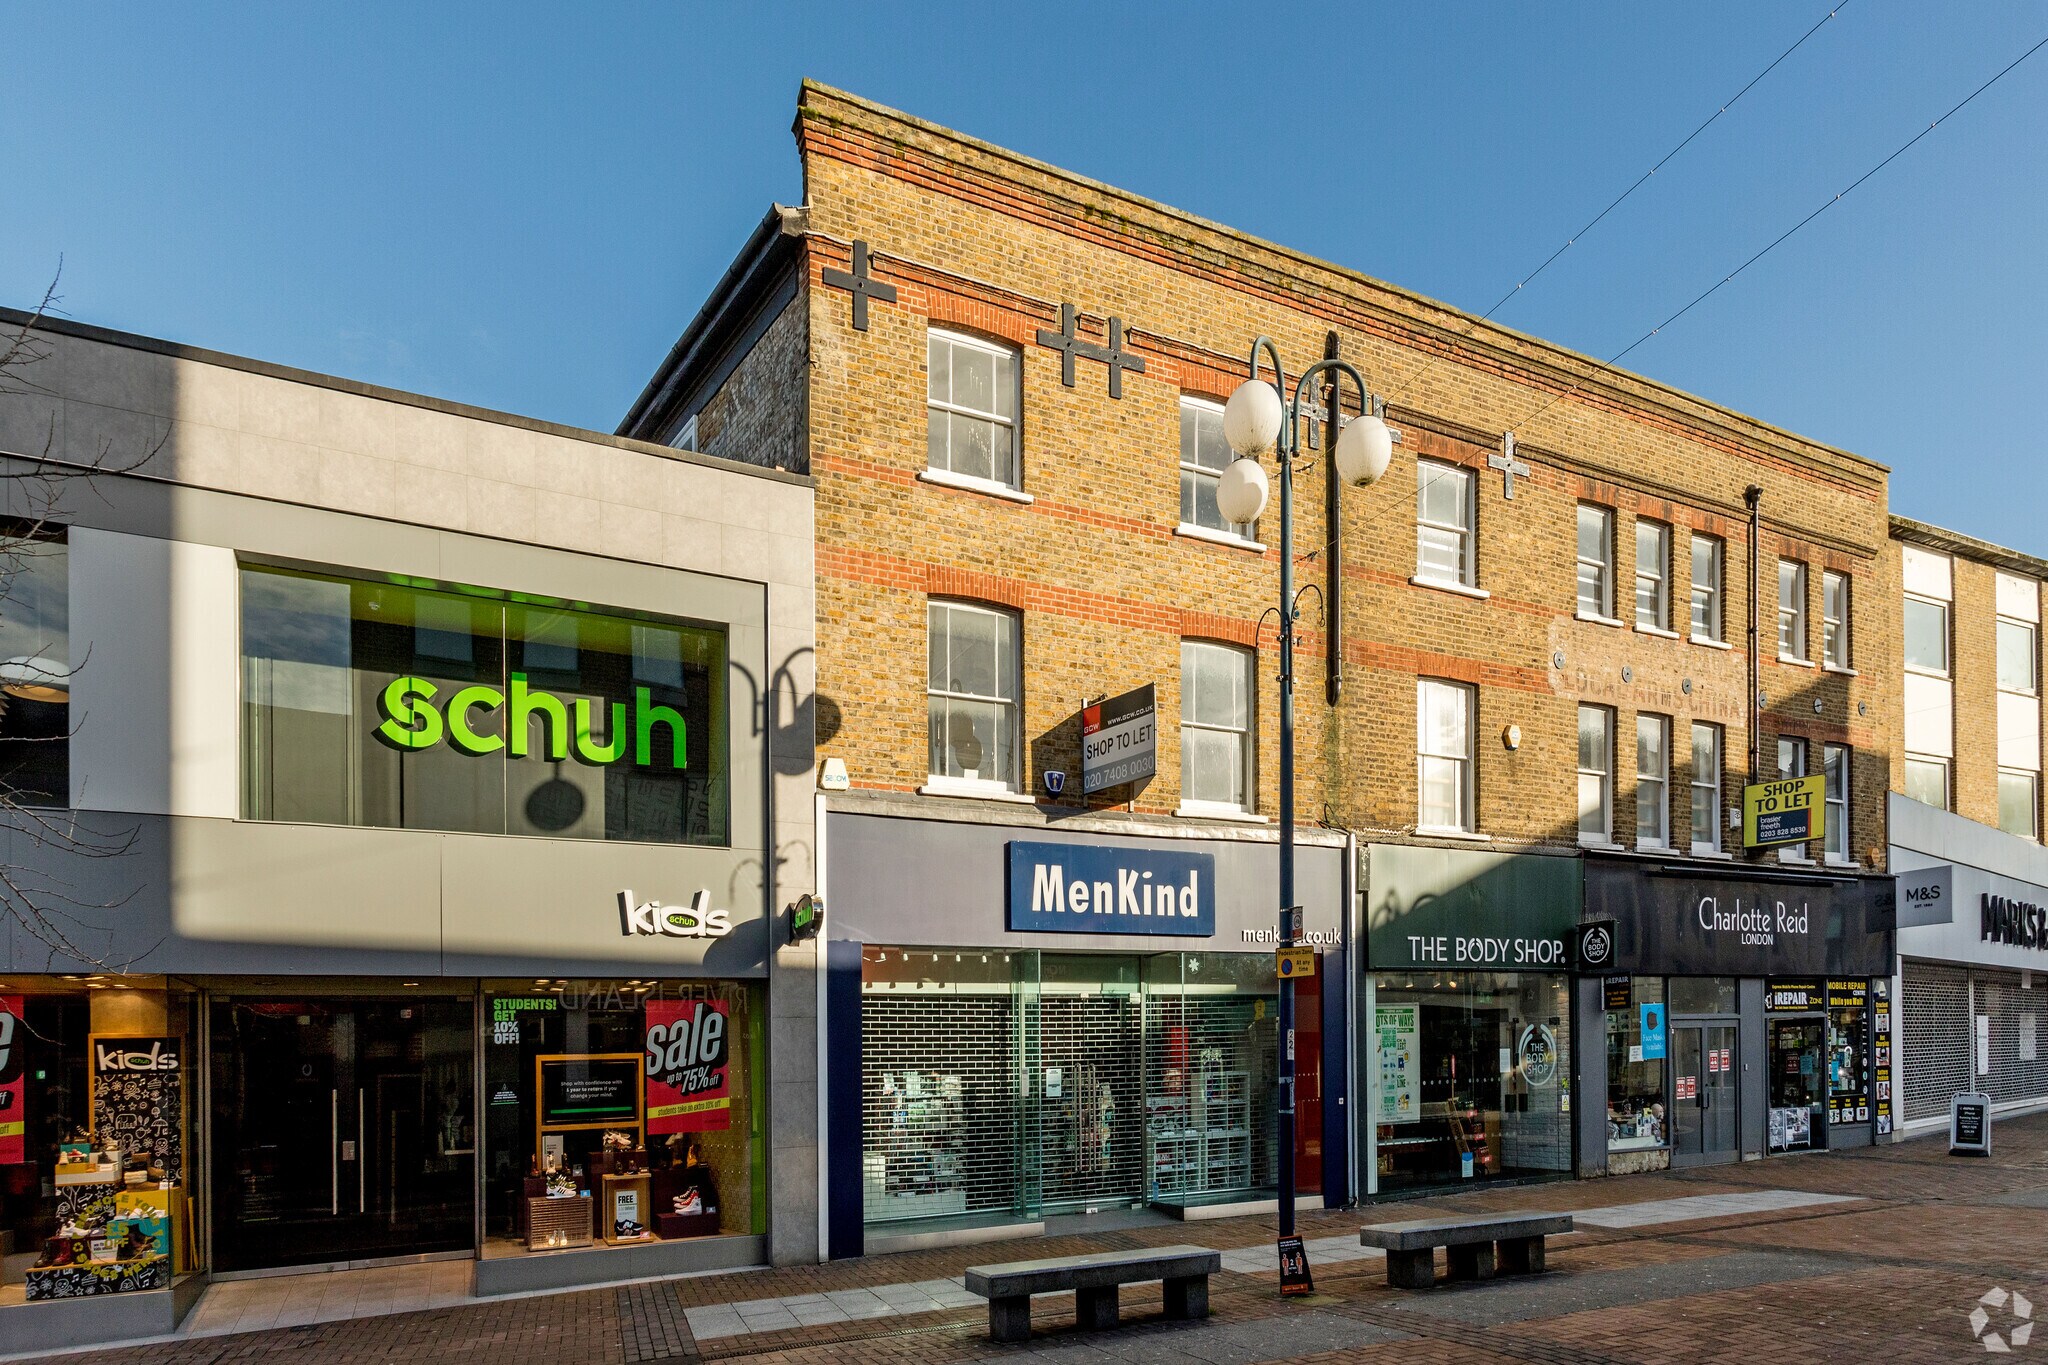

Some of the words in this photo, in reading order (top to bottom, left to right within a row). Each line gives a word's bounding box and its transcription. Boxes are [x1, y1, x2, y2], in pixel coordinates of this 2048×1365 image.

[379, 671, 687, 769] schuh
[1083, 722, 1099, 734] GCW
[1086, 737, 1113, 760] SHOP
[1116, 732, 1130, 750] TO
[1133, 724, 1152, 745] LET
[1084, 772, 1101, 789] 020
[1104, 764, 1128, 783] 7408
[1130, 755, 1154, 775] 0030
[1763, 780, 1805, 797] SHOP
[1755, 797, 1778, 813] TO
[1784, 792, 1813, 809] LET
[1760, 815, 1781, 823] brasier
[1760, 822, 1781, 830] freeth
[1760, 830, 1776, 838] 0203
[1777, 828, 1789, 836] 828
[1790, 826, 1806, 834] 8530
[1032, 863, 1198, 918] MenKind
[1906, 885, 1941, 902] M&S
[618, 889, 733, 938] kids
[795, 904, 813, 929] schuh
[1699, 897, 1770, 932] Charlotte
[1776, 901, 1808, 934] Reid
[669, 914, 696, 927] schuh
[1741, 933, 1773, 945] LONDON
[1407, 936, 1448, 962] THE
[1456, 937, 1510, 963] BODY
[1827, 981, 1847, 990] MOBILE
[1847, 982, 1867, 990] REPAIR
[1774, 991, 1808, 1005] iREPAIR
[494, 999, 557, 1010] STUDENTS!
[493, 1010, 516, 1022] GET
[1397, 1014, 1414, 1027] WAYS
[494, 1022, 518, 1033] 10%
[494, 1033, 520, 1044] OFF!
[646, 1002, 723, 1076] sale
[1289, 1031, 1294, 1039] 2
[1288, 1040, 1294, 1050] 2
[1530, 1043, 1544, 1052] THE
[97, 1041, 179, 1071] kids
[1526, 1053, 1549, 1063] BODY
[1527, 1064, 1548, 1074] SHOP
[666, 1074, 675, 1085] up
[675, 1073, 682, 1082] to
[681, 1065, 709, 1094] 75%
[709, 1074, 719, 1086] off
[657, 1106, 677, 1117] students
[618, 1195, 633, 1204] FREE
[106, 1222, 129, 1237] £5
[104, 1237, 129, 1248] OFF
